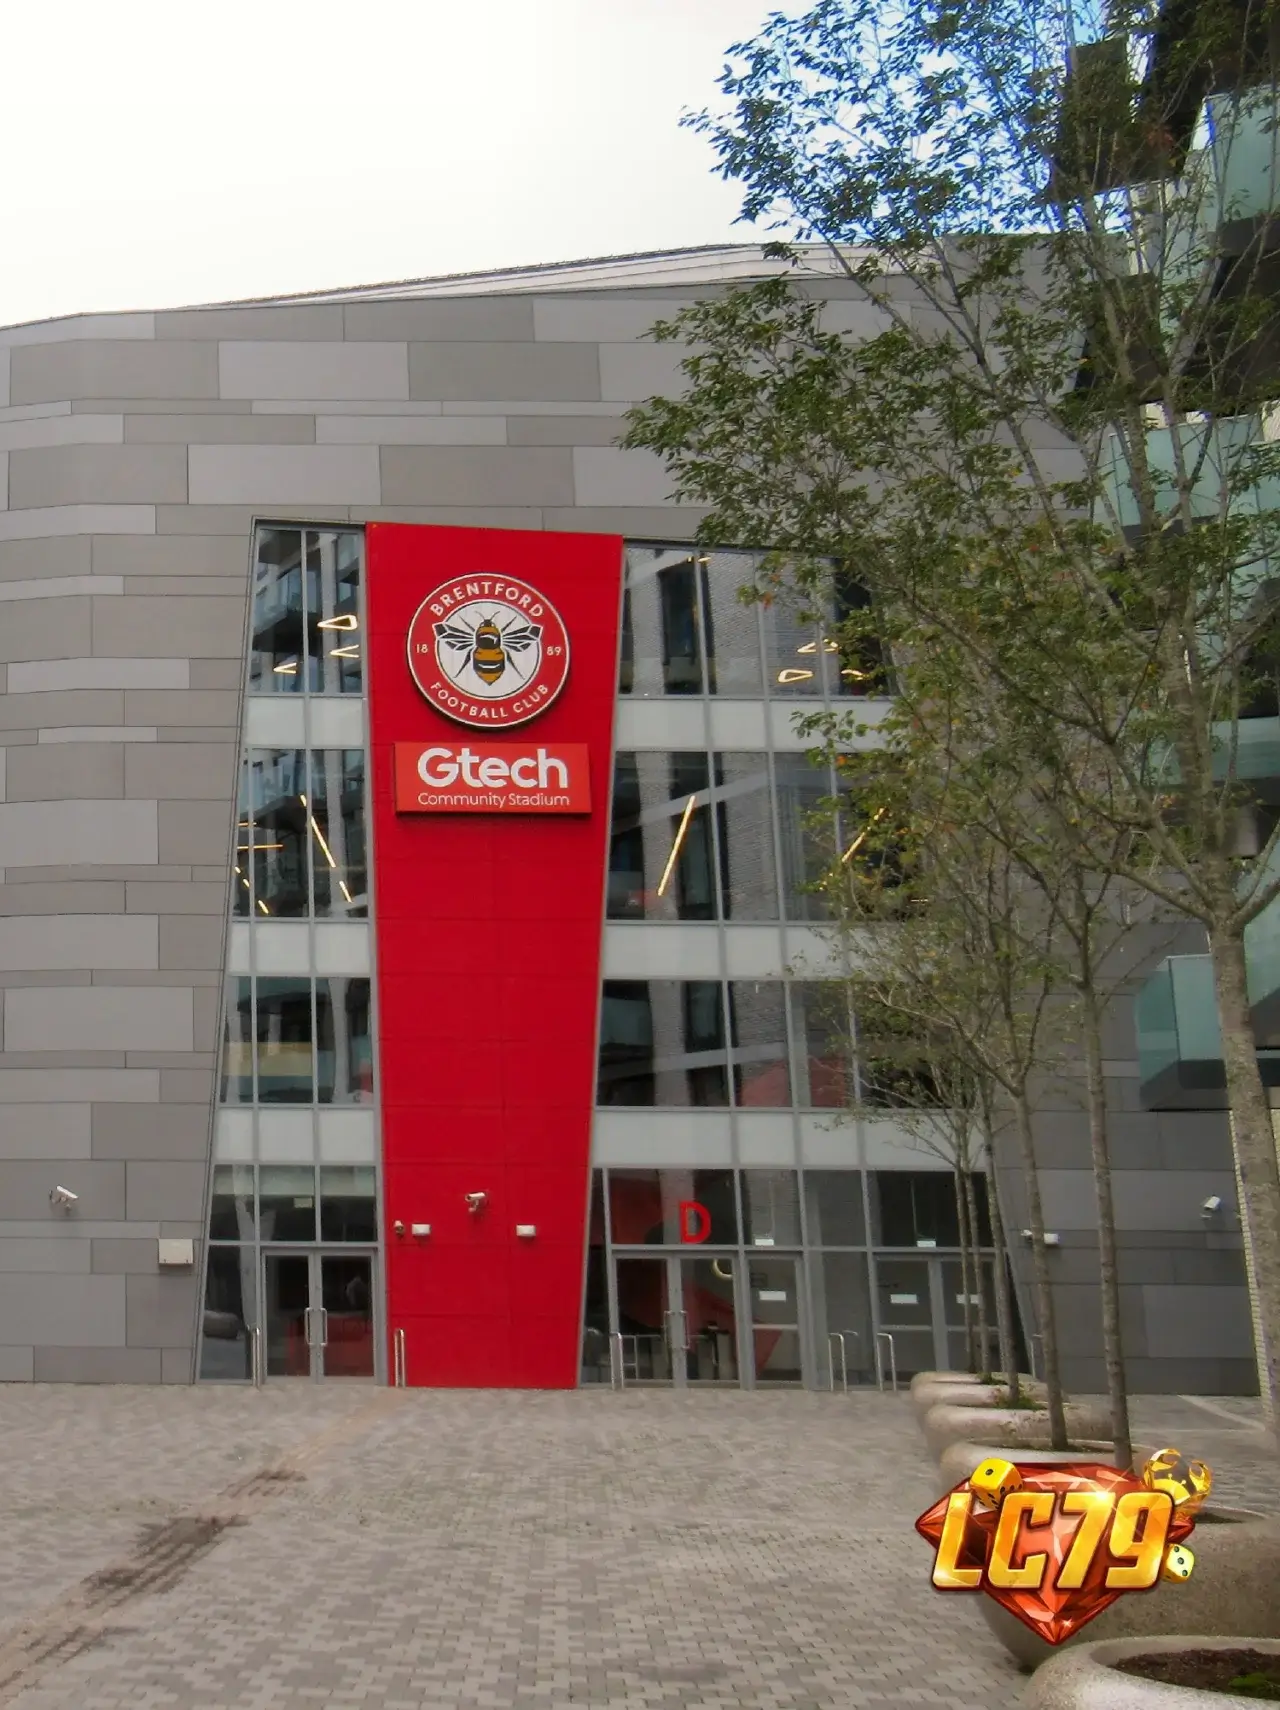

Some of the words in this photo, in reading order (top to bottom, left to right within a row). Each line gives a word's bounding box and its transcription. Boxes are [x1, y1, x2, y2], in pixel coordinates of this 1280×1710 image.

[429, 581, 544, 618] BRENTFORD
[415, 644, 429, 654] 18
[546, 646, 562, 656] 89
[430, 682, 508, 719] FOOTBALL
[512, 683, 550, 714] CLUB
[417, 747, 569, 789] Gtech
[417, 791, 507, 809] Community
[508, 792, 570, 807] Stadium
[678, 1200, 712, 1244] D
